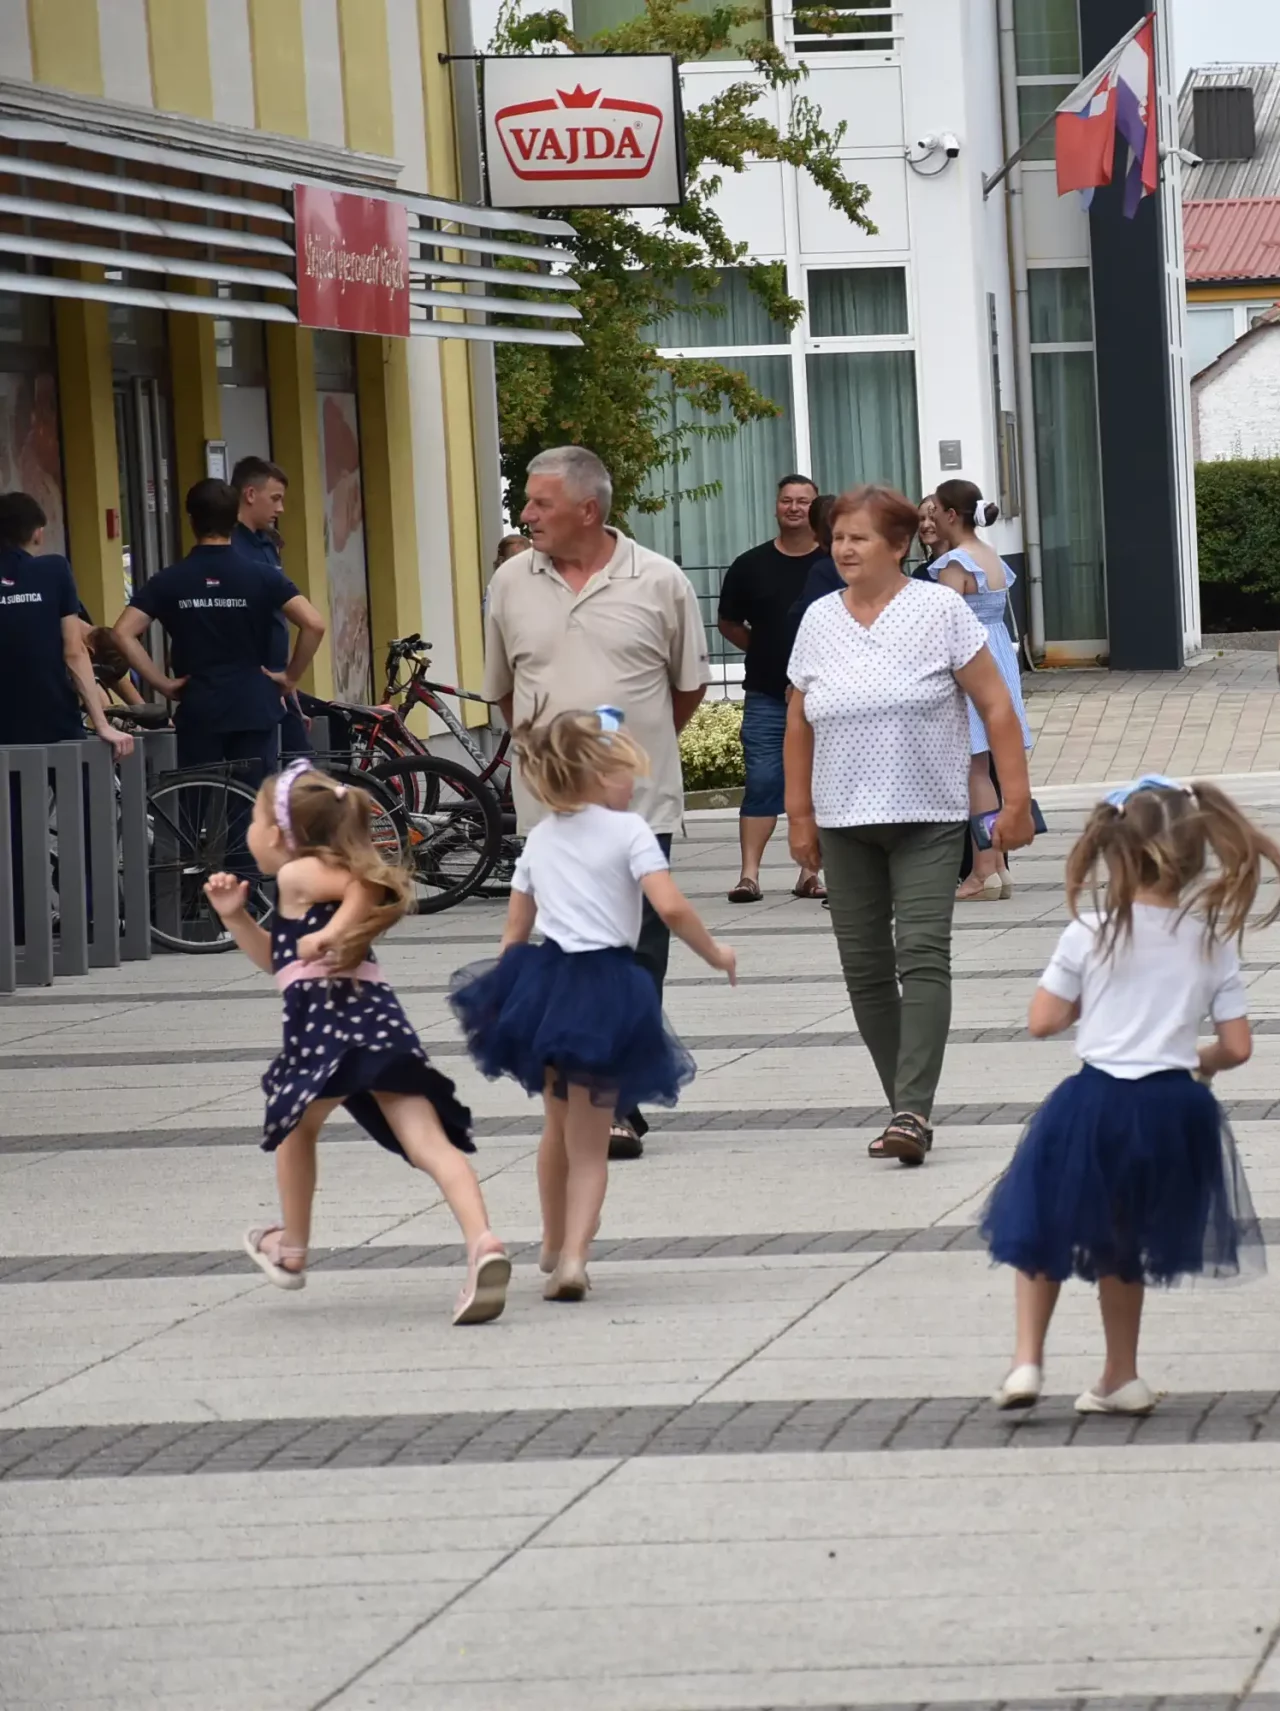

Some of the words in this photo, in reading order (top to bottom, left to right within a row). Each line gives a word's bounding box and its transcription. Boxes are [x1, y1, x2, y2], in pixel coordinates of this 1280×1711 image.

[509, 126, 645, 164] VAJDA
[7, 592, 43, 604] SUBOTICA
[192, 597, 213, 608] MALA
[214, 597, 248, 608] SUBOTICA
